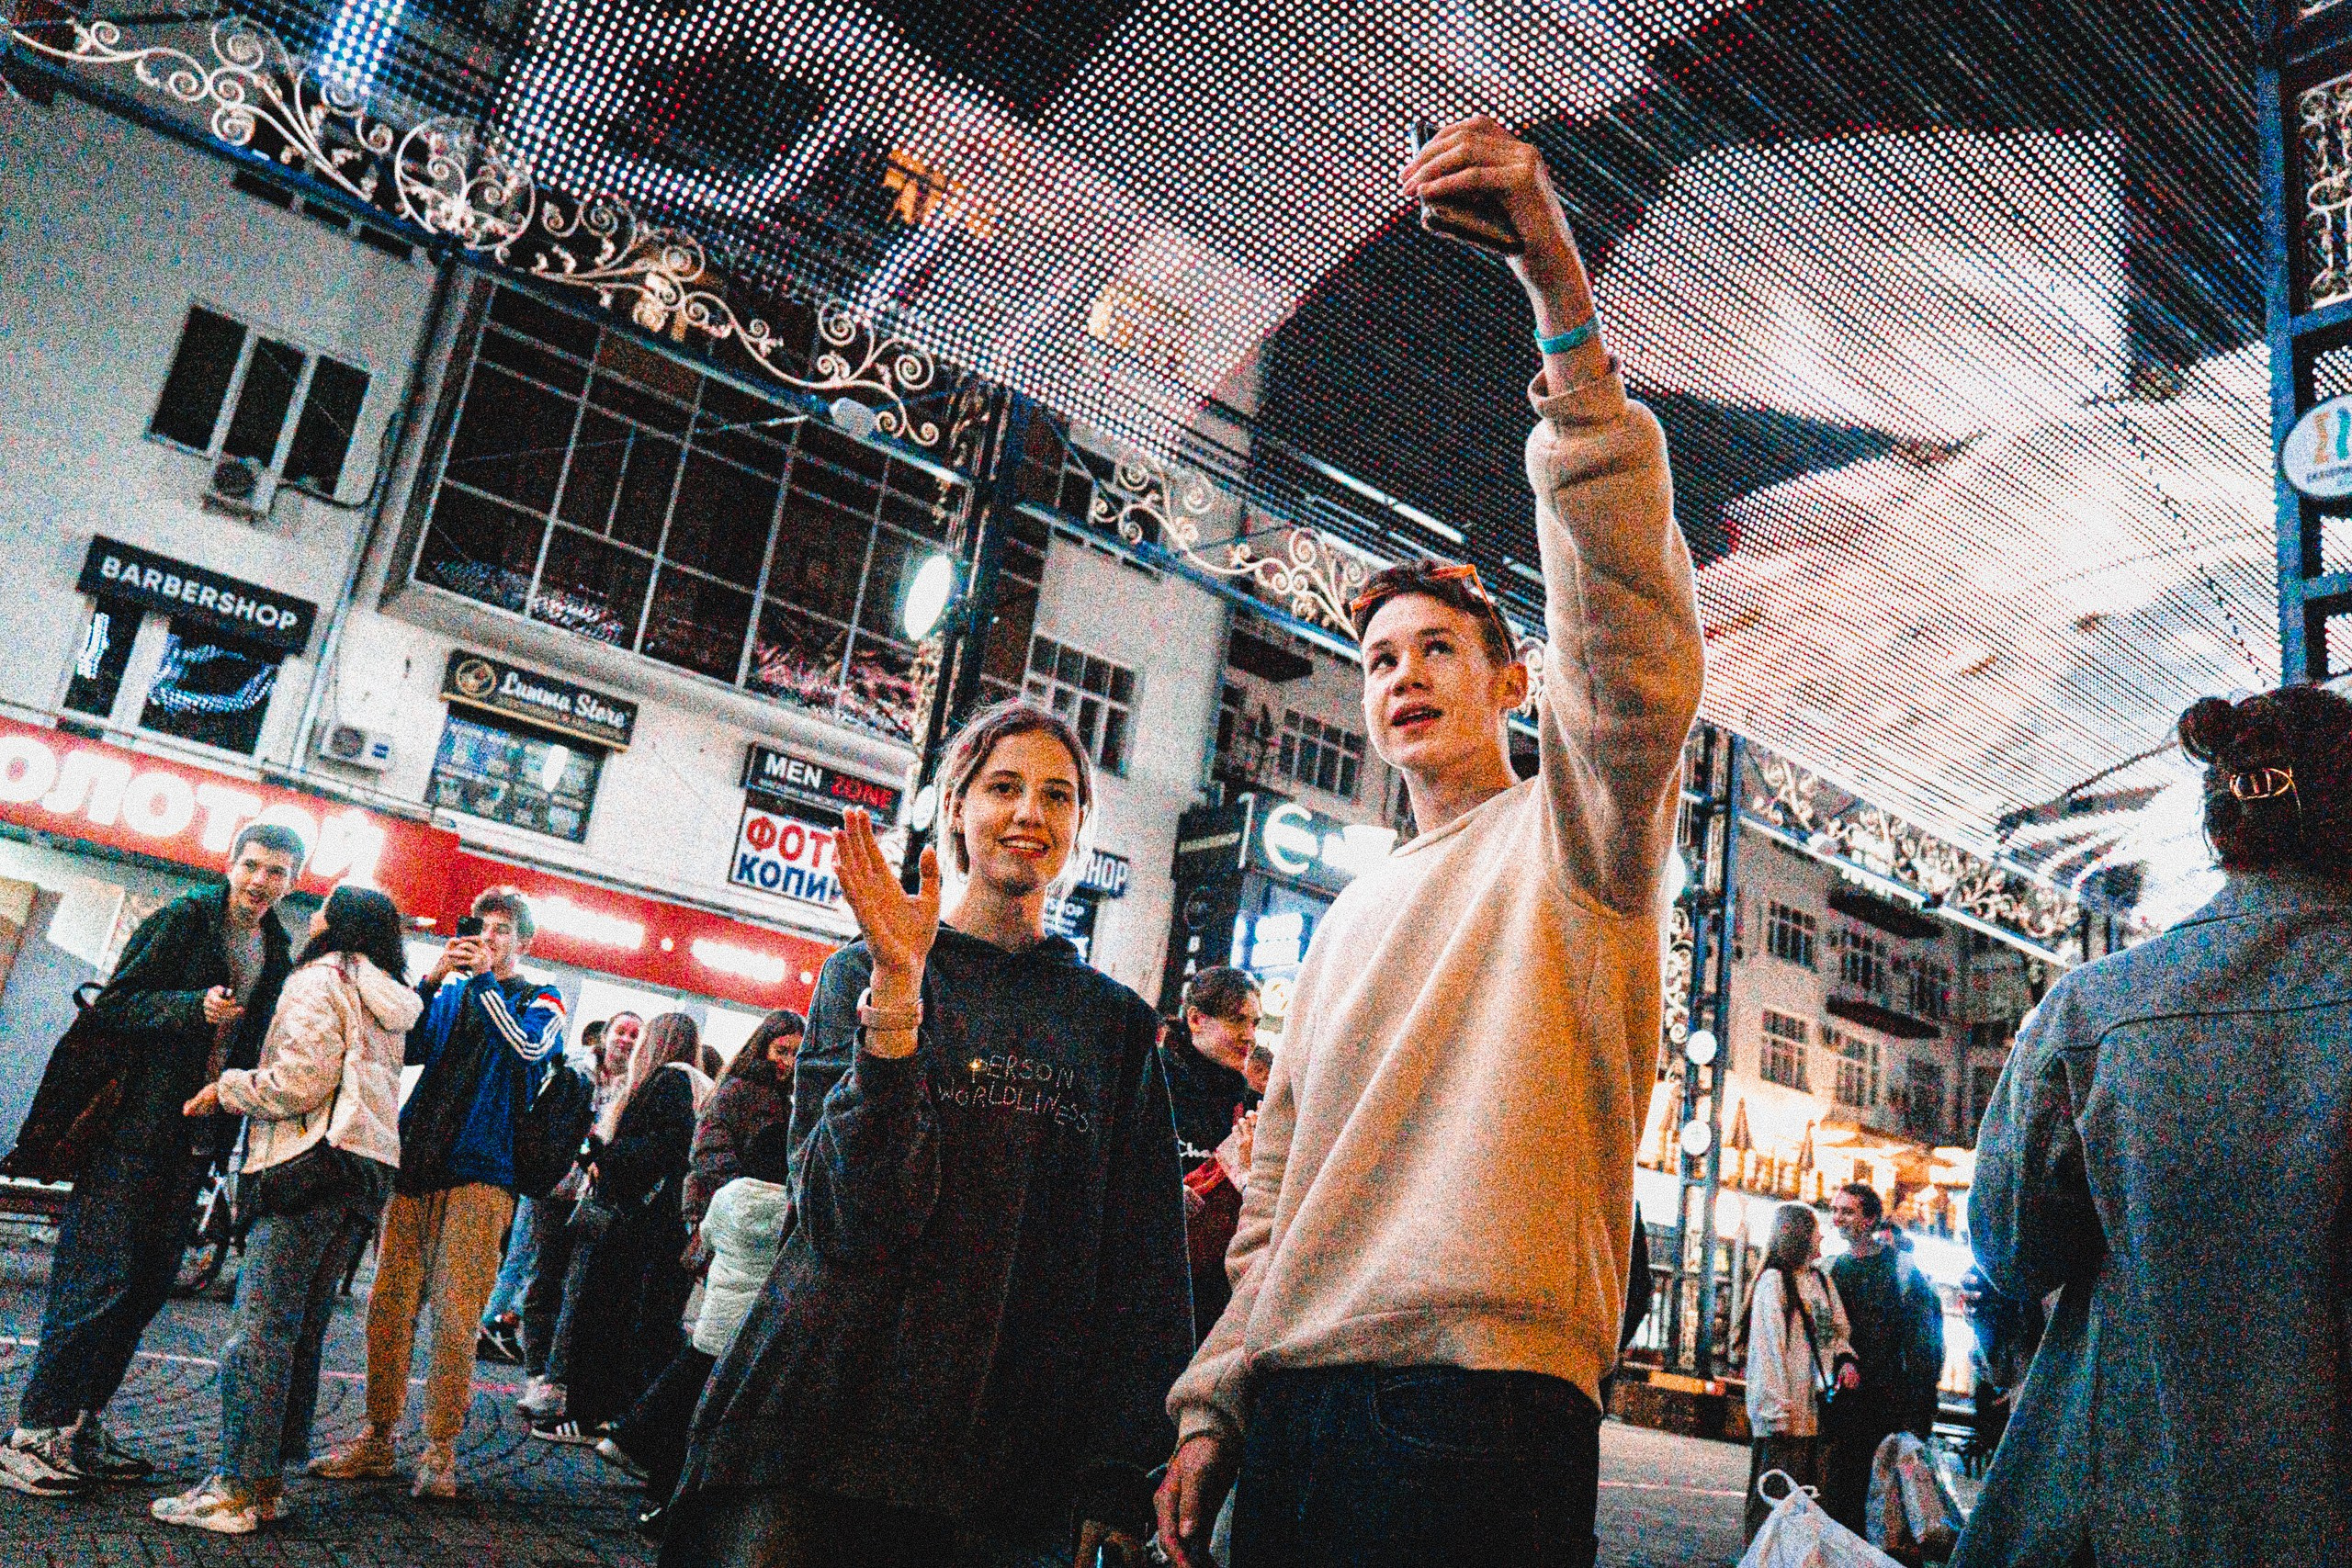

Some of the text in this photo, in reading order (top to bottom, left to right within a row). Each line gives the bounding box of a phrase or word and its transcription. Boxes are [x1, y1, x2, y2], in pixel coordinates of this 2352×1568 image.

[100, 555, 298, 631] BARBERSHOP
[574, 692, 626, 729] Store
[763, 753, 823, 789] MEN
[830, 773, 894, 810] ZONE
[746, 816, 840, 869] ФОТ
[1084, 852, 1128, 893] HOP
[969, 1054, 1074, 1089] PERSON
[936, 1076, 1090, 1134] WORLDLINES
